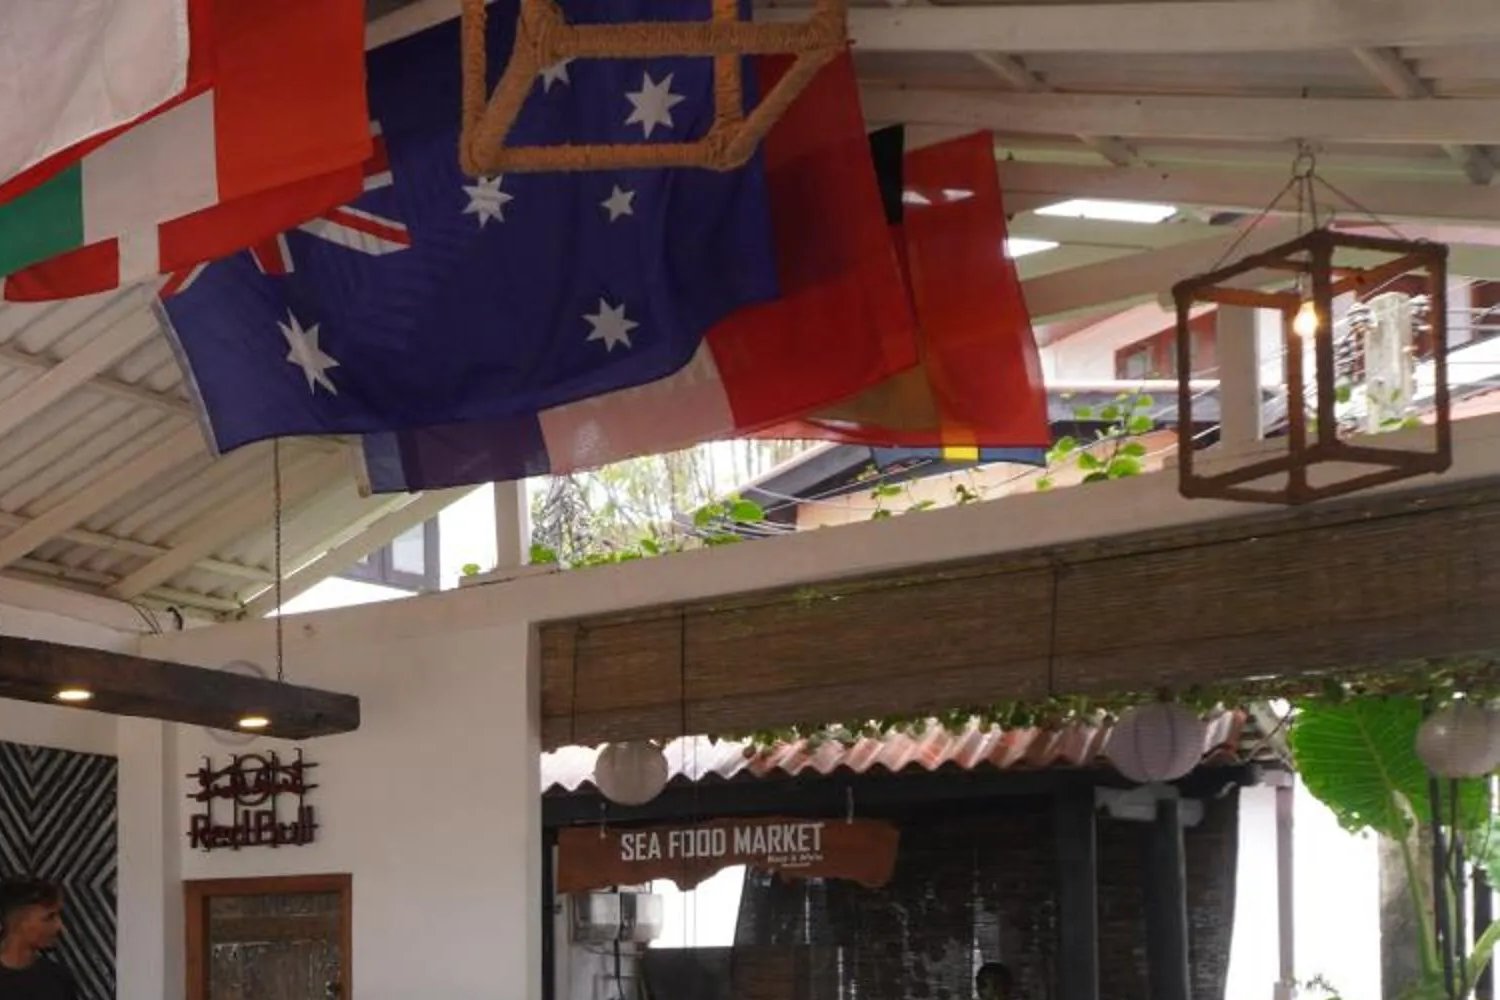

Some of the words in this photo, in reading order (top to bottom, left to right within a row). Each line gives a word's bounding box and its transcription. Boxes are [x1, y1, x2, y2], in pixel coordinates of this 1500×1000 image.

[621, 832, 662, 861] SEA
[669, 828, 726, 859] FOOD
[734, 822, 825, 855] MARKET
